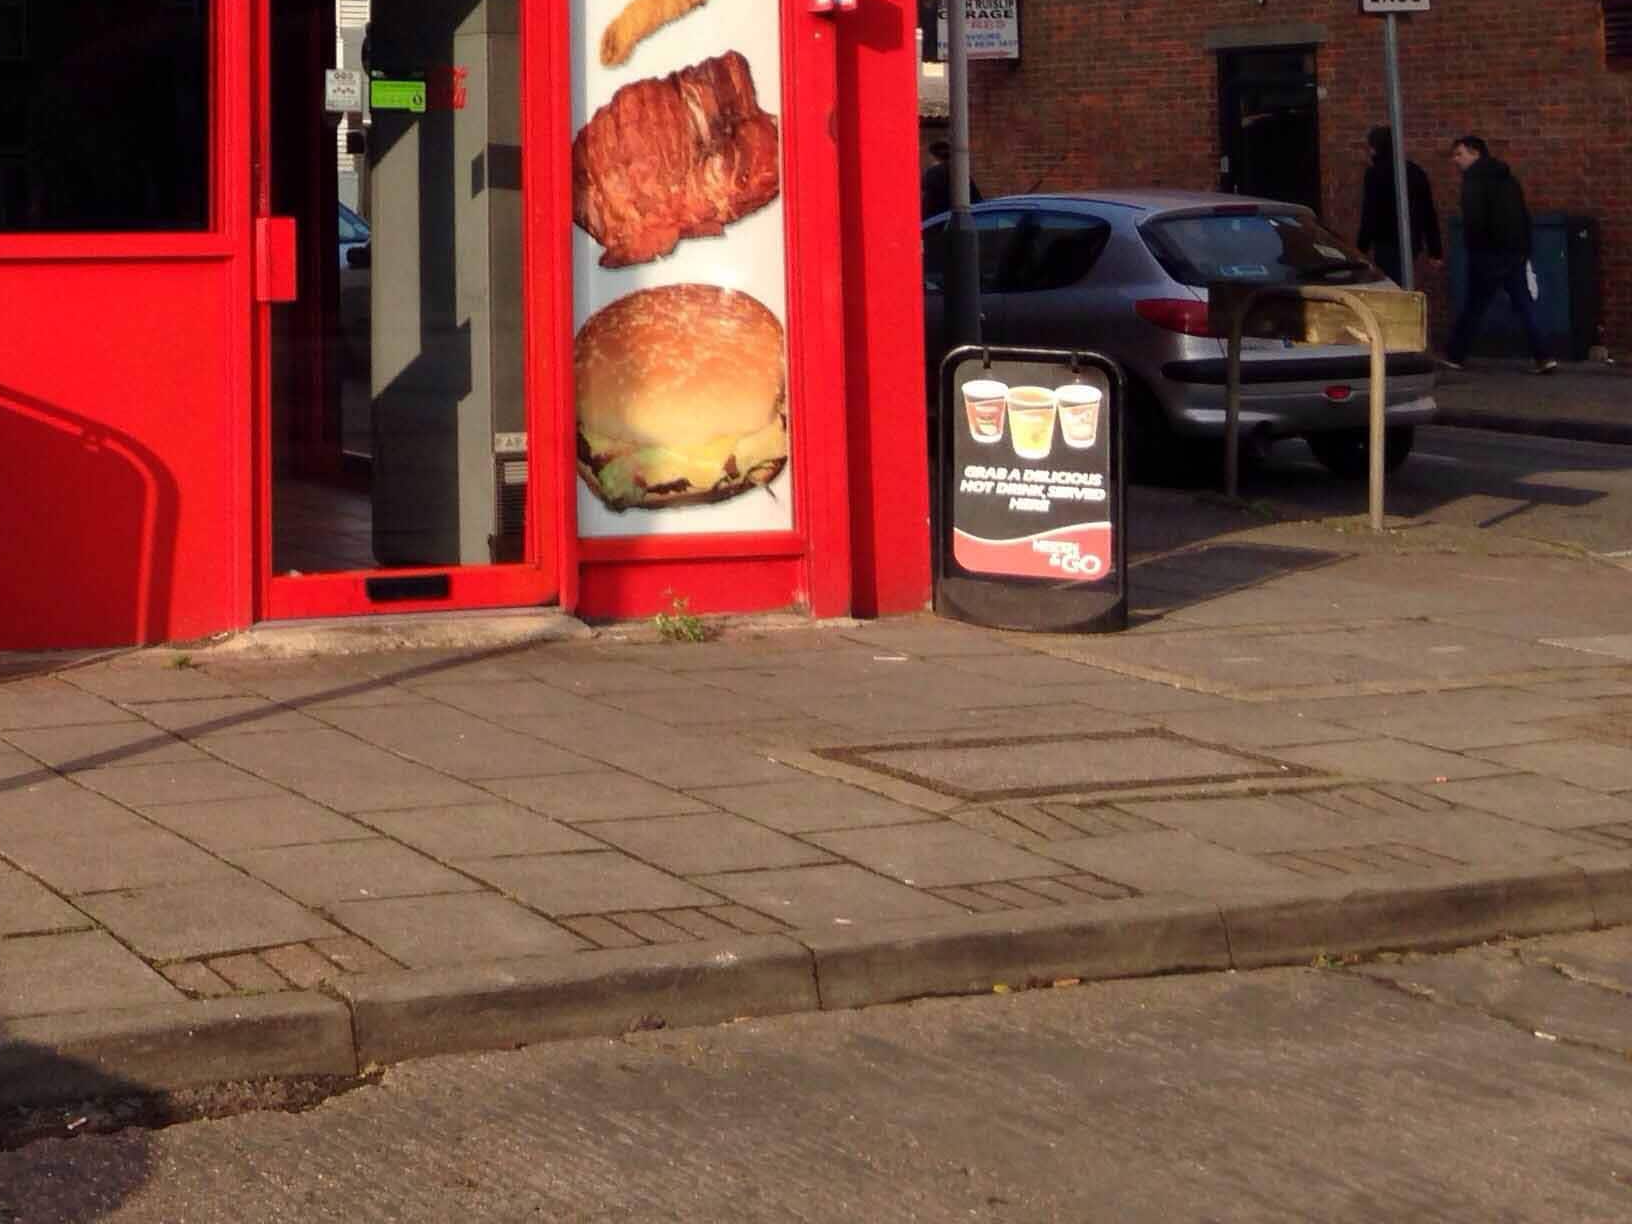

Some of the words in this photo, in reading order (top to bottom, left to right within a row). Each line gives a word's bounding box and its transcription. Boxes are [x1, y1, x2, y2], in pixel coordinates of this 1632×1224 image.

[964, 465, 1008, 480] GRAB
[1008, 468, 1021, 481] A
[1023, 469, 1104, 486] DELICIOUS
[960, 479, 995, 494] HOT
[1047, 485, 1107, 502] SERVED
[1061, 553, 1102, 573] GO
